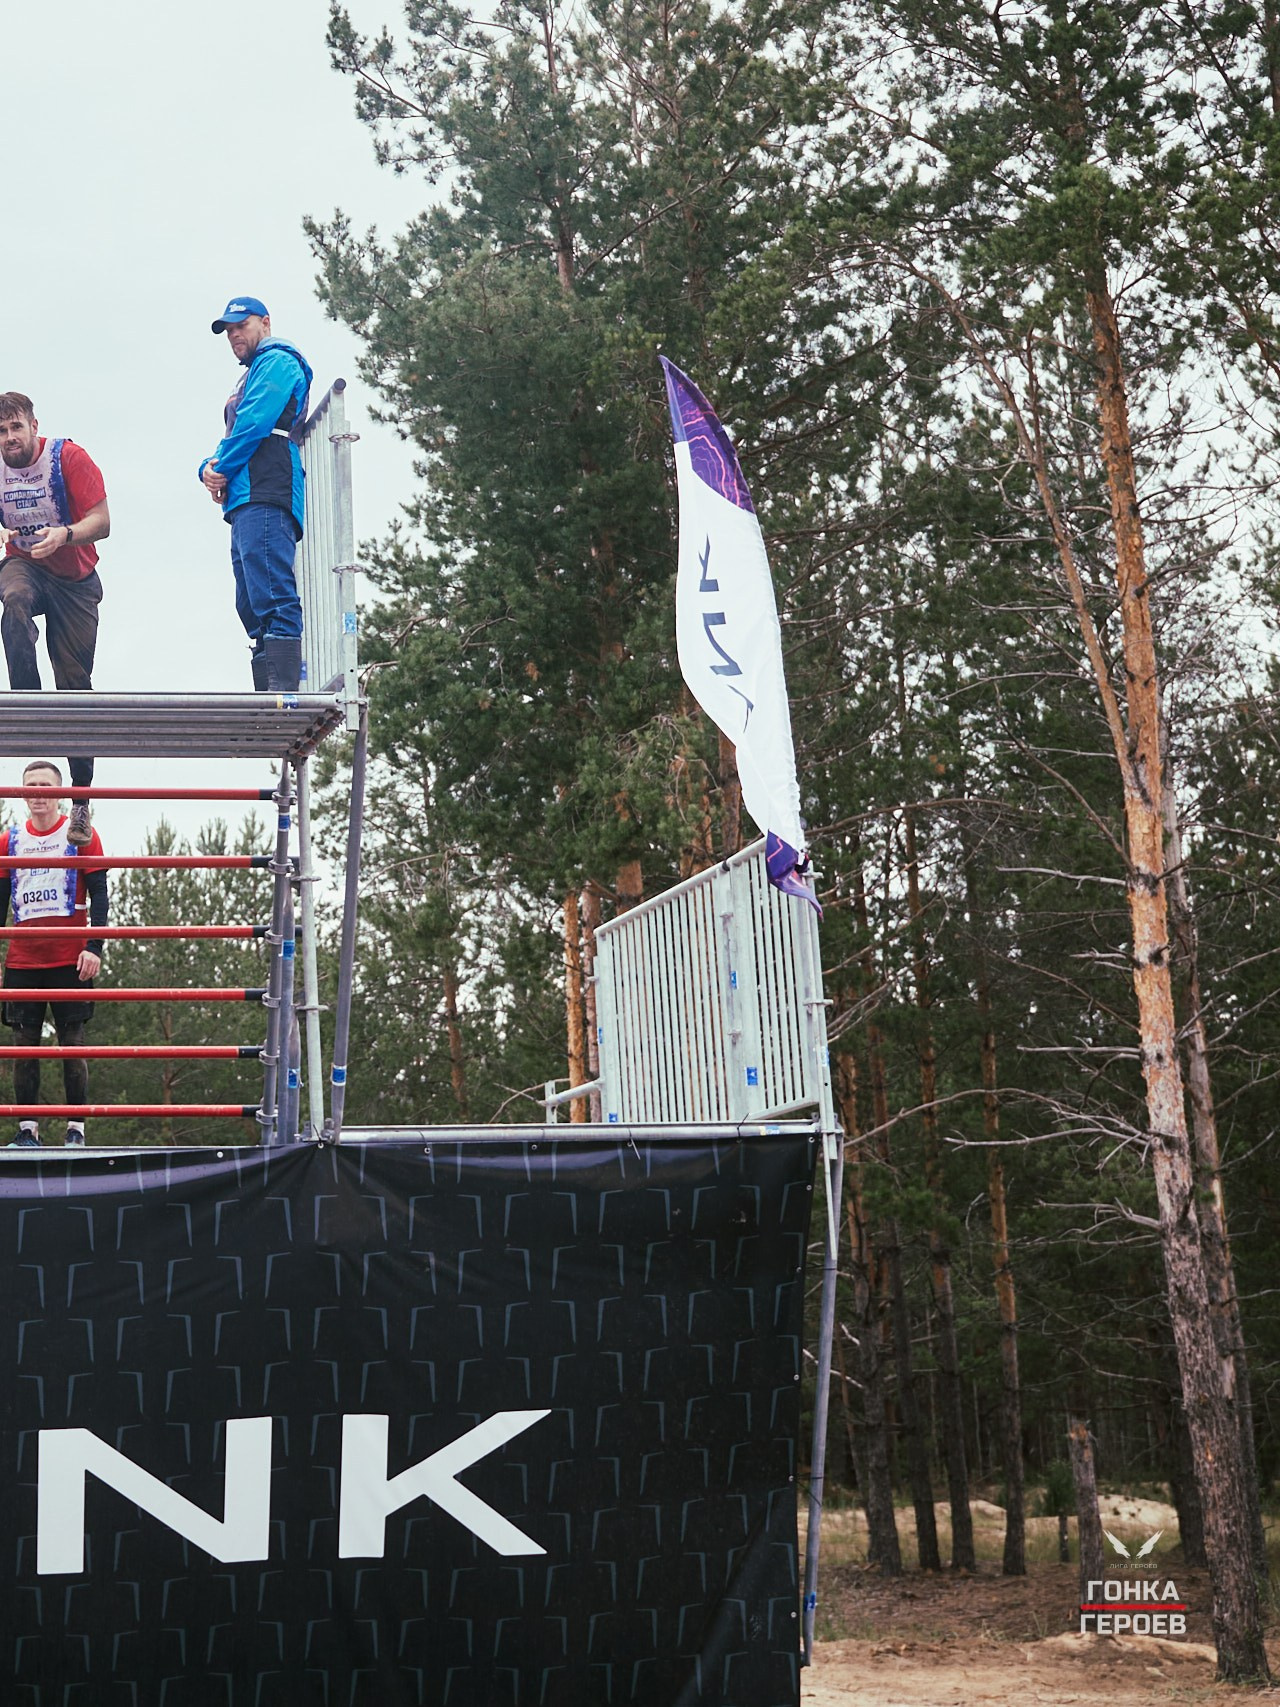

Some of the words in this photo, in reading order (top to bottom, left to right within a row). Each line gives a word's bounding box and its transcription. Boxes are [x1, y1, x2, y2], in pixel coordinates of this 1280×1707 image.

[17, 500, 36, 508] СТАРТ
[8, 510, 48, 522] РОМАН
[23, 889, 58, 904] 03203
